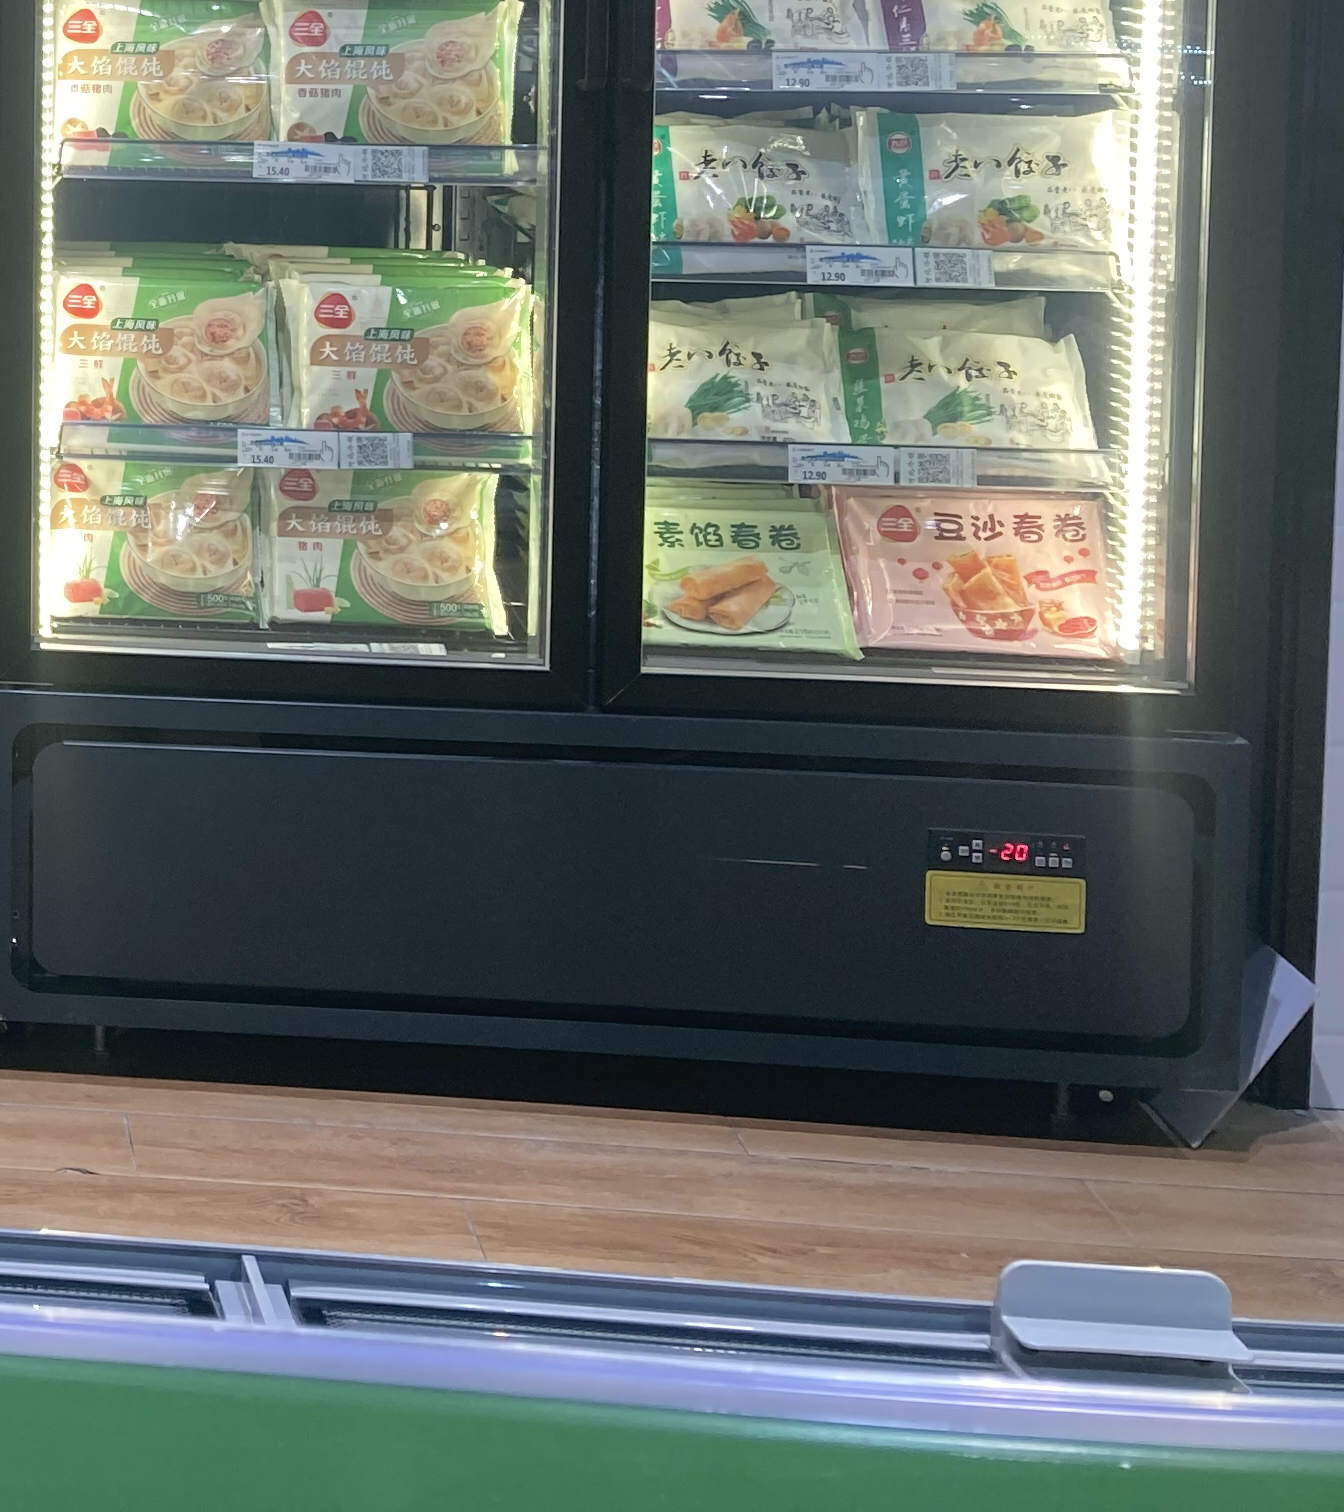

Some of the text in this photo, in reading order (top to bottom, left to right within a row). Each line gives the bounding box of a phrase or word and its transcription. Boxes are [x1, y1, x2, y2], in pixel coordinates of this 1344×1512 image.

[66, 20, 99, 34] 三全
[292, 22, 325, 37] 三全
[111, 42, 160, 55] 上海风味
[340, 44, 389, 58] 上海风味
[65, 56, 164, 77] 大馅馄饨
[295, 58, 395, 80] 大馅馄饨
[786, 78, 810, 88] 12.90
[297, 87, 343, 99] 香菇猪肉
[266, 166, 290, 176] 15.40
[821, 271, 846, 282] 12.90
[67, 294, 98, 309] 三全
[318, 304, 350, 319] 三全
[112, 318, 158, 332] 上海风味
[364, 328, 413, 342] 上海风味
[66, 332, 163, 354] 大馅馄饨
[318, 342, 418, 365] 大馅馄饨
[330, 370, 358, 381] 三鲜
[251, 455, 275, 465] 15.40
[803, 470, 827, 481] 12.90
[280, 476, 314, 491] 三全
[101, 495, 147, 507] 上海风味
[328, 500, 378, 513] 上海风味
[285, 512, 384, 536] 大馅馄饨
[881, 518, 914, 533] 三全
[933, 511, 1088, 543] 豆沙春卷
[654, 520, 801, 551] 素馅春卷
[297, 541, 324, 553] 猪肉
[988, 843, 1029, 862] -20
